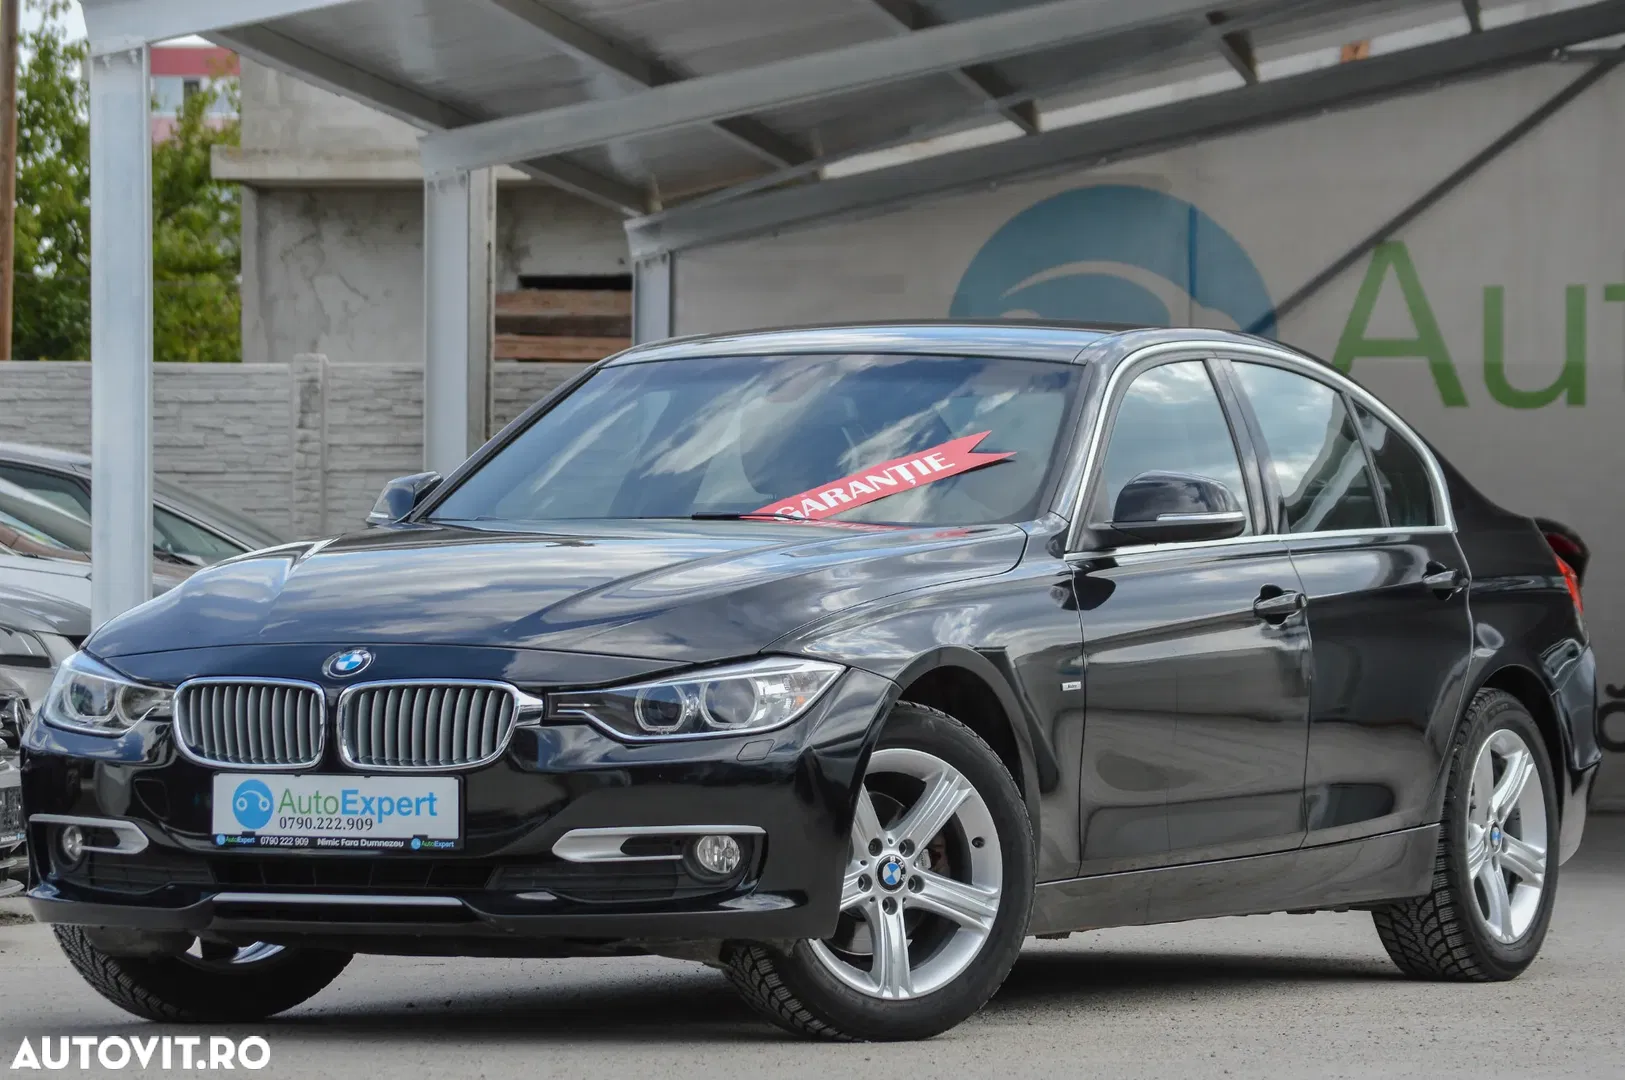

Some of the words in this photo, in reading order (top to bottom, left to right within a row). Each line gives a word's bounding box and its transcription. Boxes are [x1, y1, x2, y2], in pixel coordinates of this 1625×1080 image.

[1331, 240, 1625, 410] Au
[278, 788, 438, 823] AutoExpert
[279, 816, 373, 831] 0790.222.909
[260, 836, 279, 846] 0790
[279, 836, 294, 846] 222
[294, 837, 310, 847] 909
[317, 838, 340, 847] Nimic
[341, 838, 359, 848] Fara
